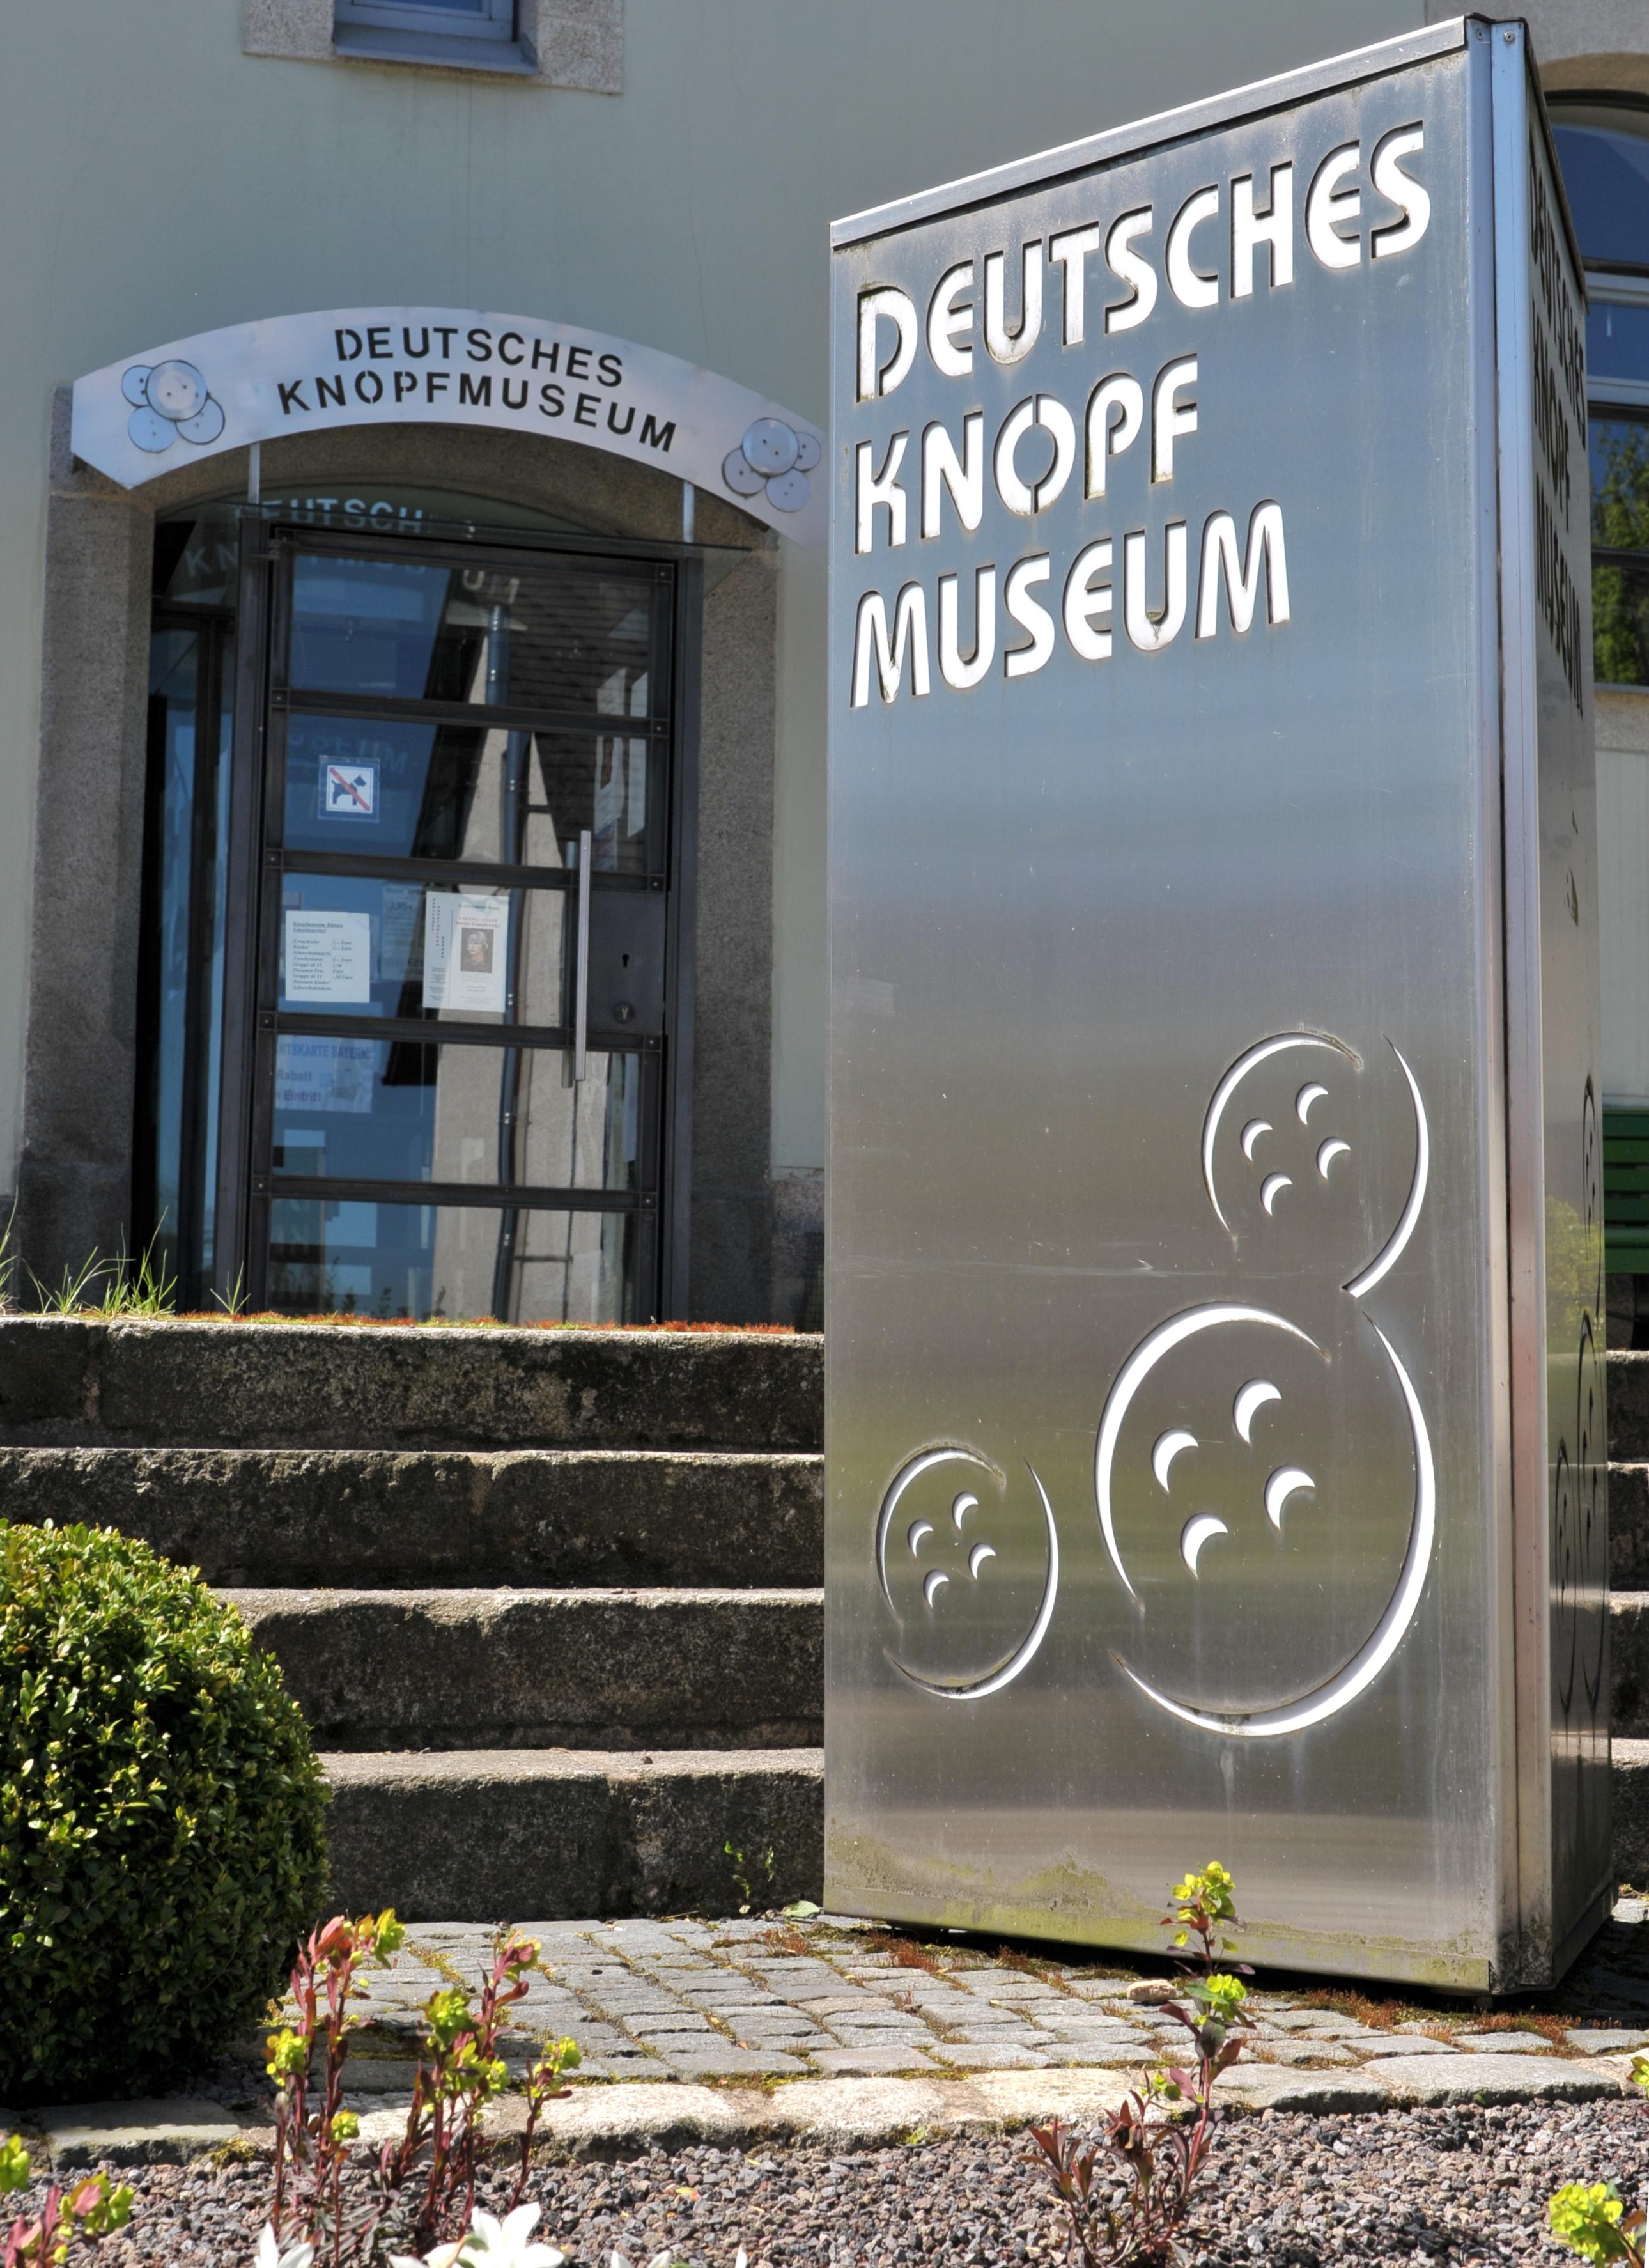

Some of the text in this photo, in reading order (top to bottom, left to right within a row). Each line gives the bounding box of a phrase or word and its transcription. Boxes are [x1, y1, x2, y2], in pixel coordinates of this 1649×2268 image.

[335, 327, 623, 387] DEUTSCHES
[856, 120, 1431, 403] DEUTSCHES
[1529, 123, 1586, 451] DEUTSCHES
[278, 369, 676, 452] KNOPFMUSEUM
[855, 352, 1198, 555] KNOPF
[1533, 288, 1570, 534] KNOPF
[849, 498, 1291, 708] MUSEUM
